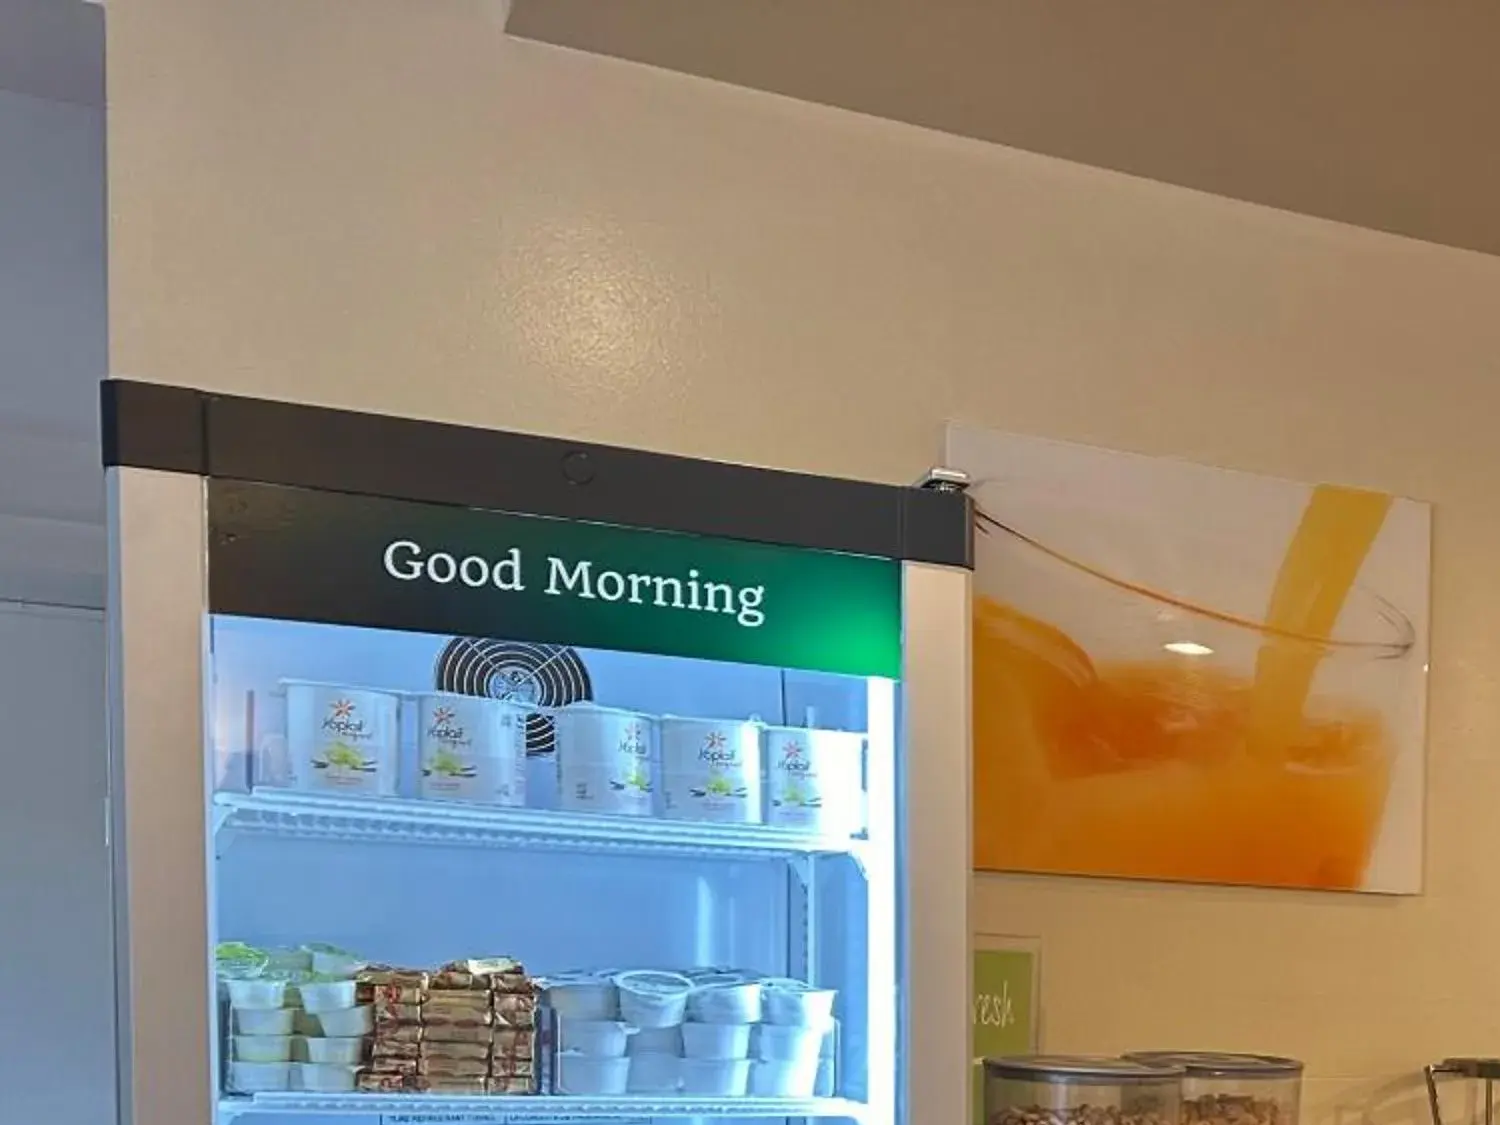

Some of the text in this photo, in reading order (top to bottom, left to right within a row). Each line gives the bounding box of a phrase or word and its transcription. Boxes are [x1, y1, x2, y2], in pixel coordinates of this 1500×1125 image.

[383, 540, 764, 627] Good Morning
[973, 980, 1014, 1028] resh
